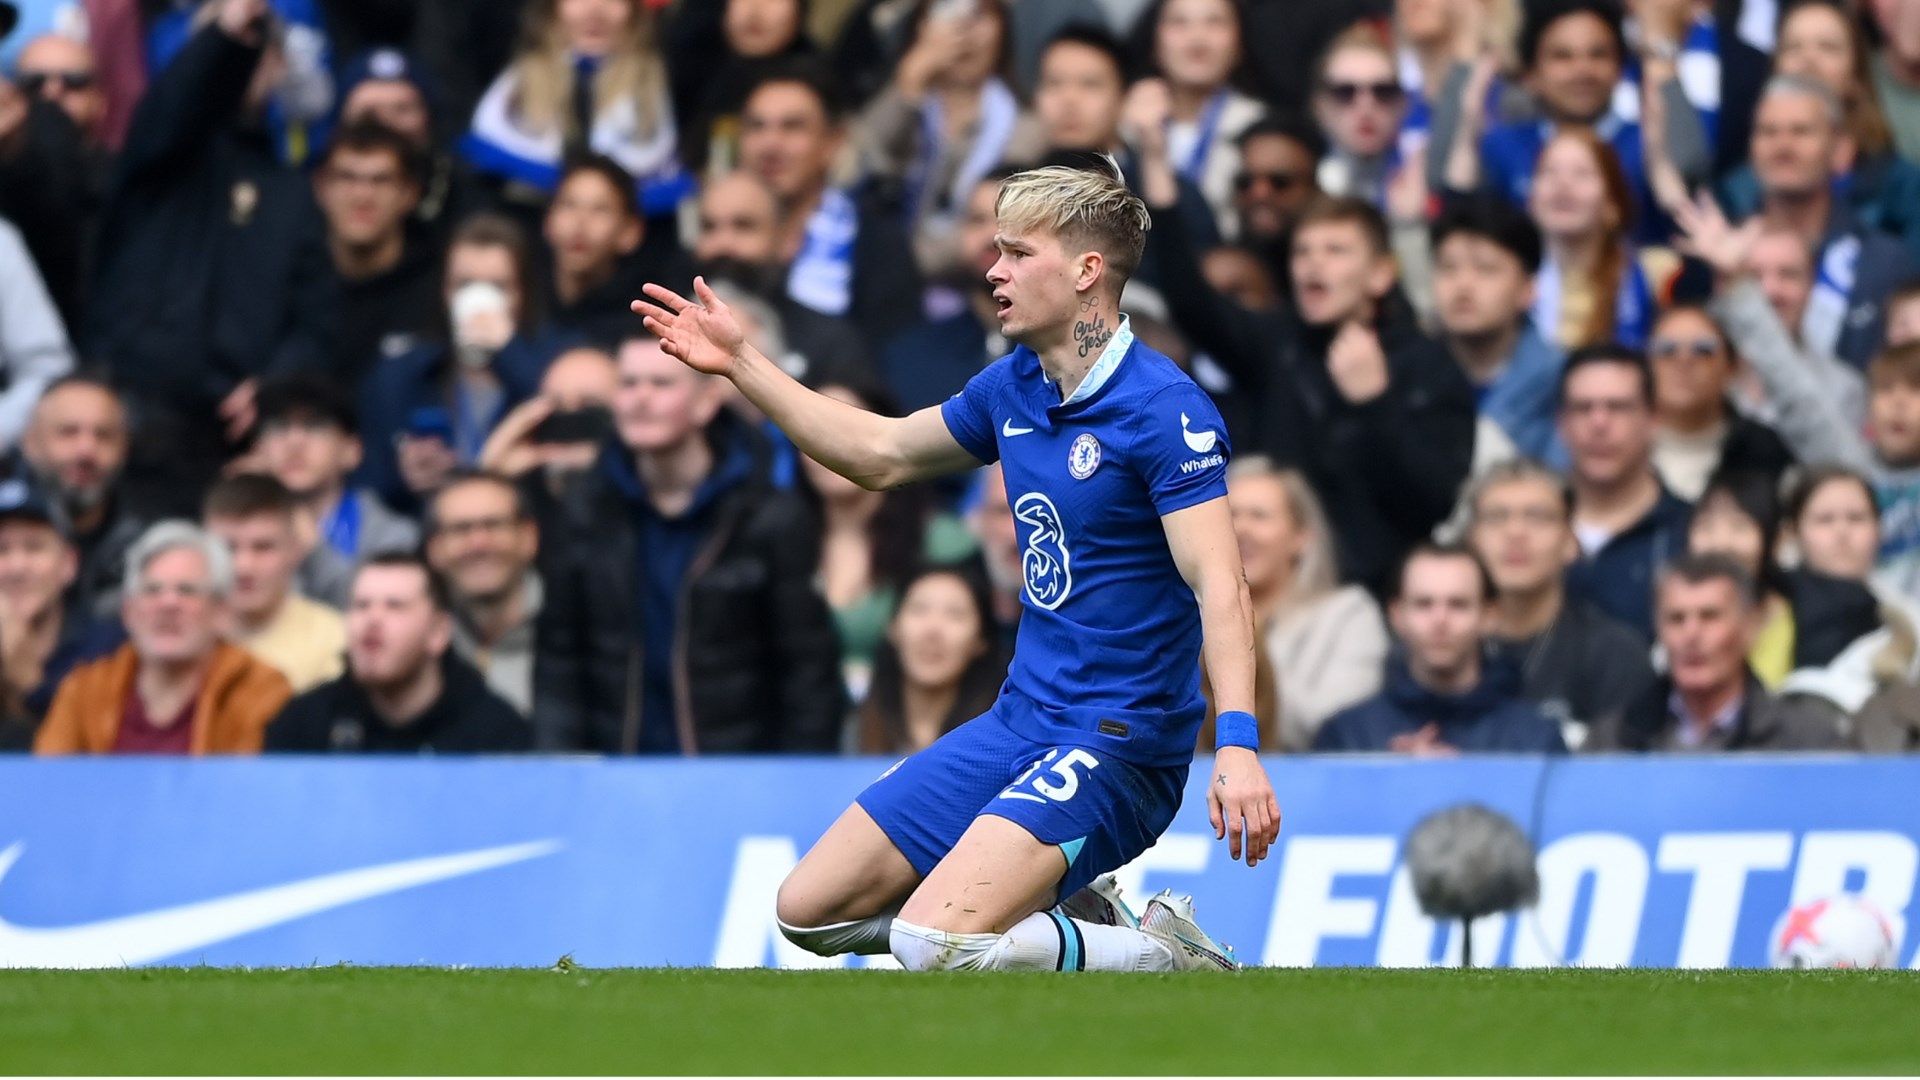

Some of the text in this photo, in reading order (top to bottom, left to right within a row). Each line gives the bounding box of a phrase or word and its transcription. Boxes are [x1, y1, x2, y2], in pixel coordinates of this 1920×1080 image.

[1074, 312, 1104, 341] Only
[1078, 328, 1112, 358] Jesus
[1262, 830, 1920, 969] FOOTB
